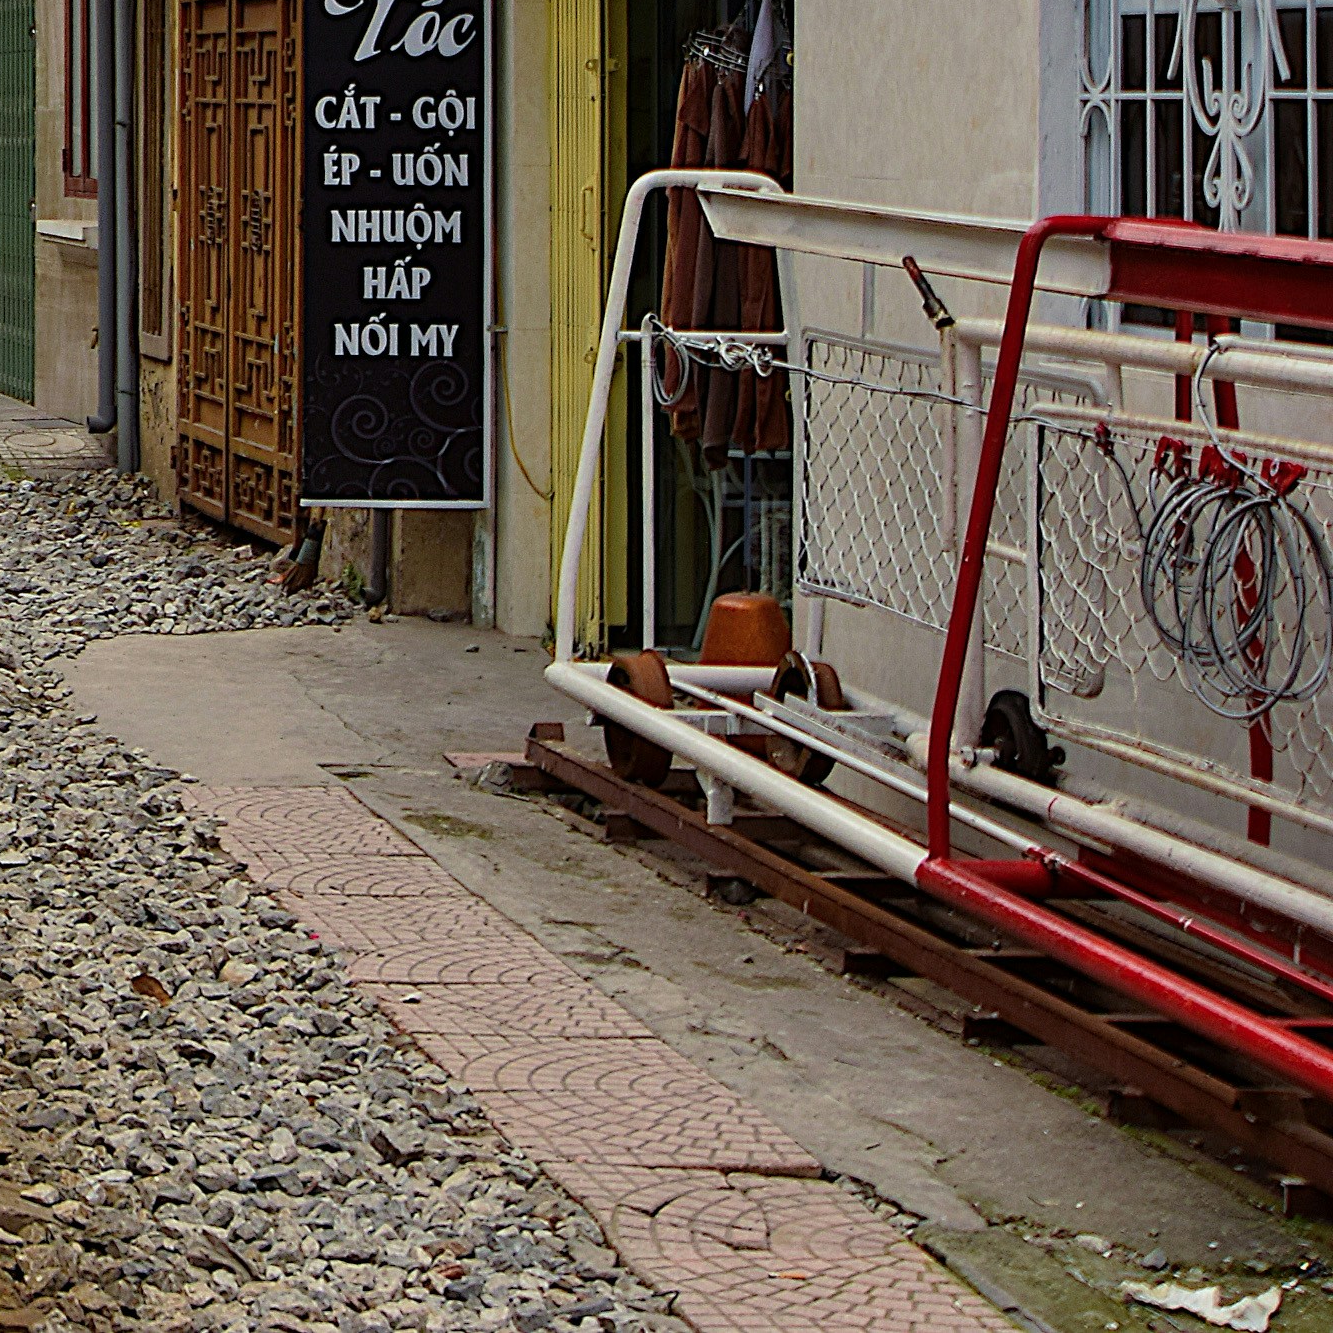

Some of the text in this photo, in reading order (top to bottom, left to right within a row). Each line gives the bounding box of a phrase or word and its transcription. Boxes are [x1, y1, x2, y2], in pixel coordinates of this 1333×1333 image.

[314, 83, 381, 130] CẮT
[412, 89, 476, 137] GỘI
[323, 144, 360, 187] ÉP
[391, 142, 469, 187] UỐN
[330, 203, 462, 250] NHUỘM
[362, 255, 431, 300] HẤP
[333, 312, 459, 357] NỐI MY
